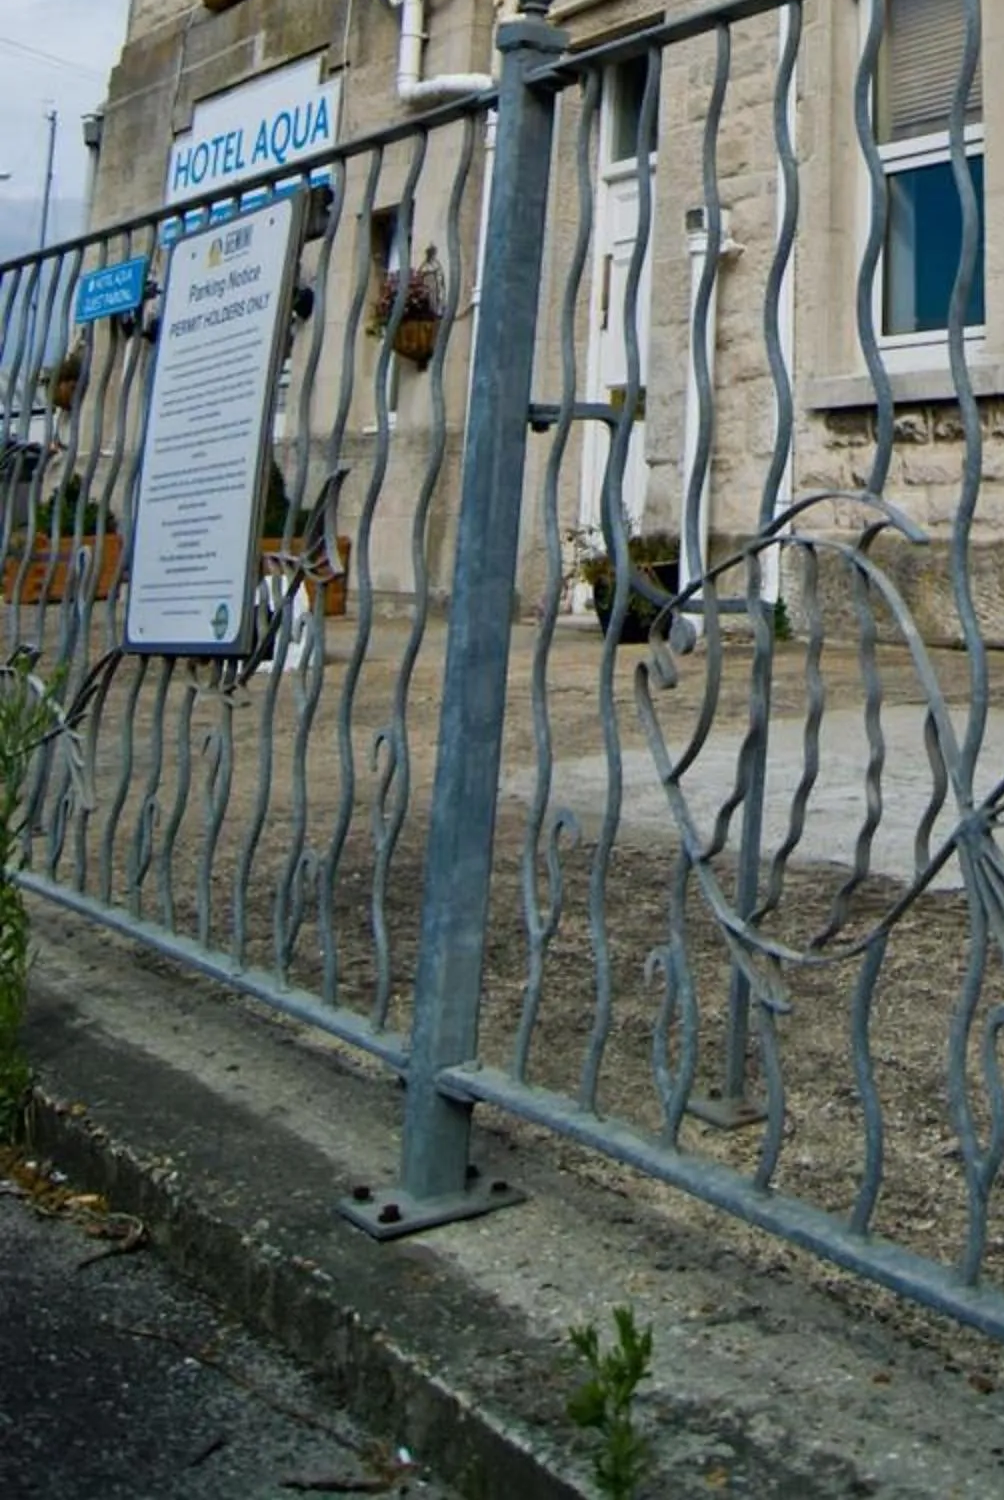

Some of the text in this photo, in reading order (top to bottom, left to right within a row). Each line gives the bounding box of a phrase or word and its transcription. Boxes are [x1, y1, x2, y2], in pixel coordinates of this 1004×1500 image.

[173, 97, 330, 191] HOTEL AQUA
[189, 264, 261, 303] Parking Notice
[169, 293, 271, 339] PERMIT HOLDERS ONLY
